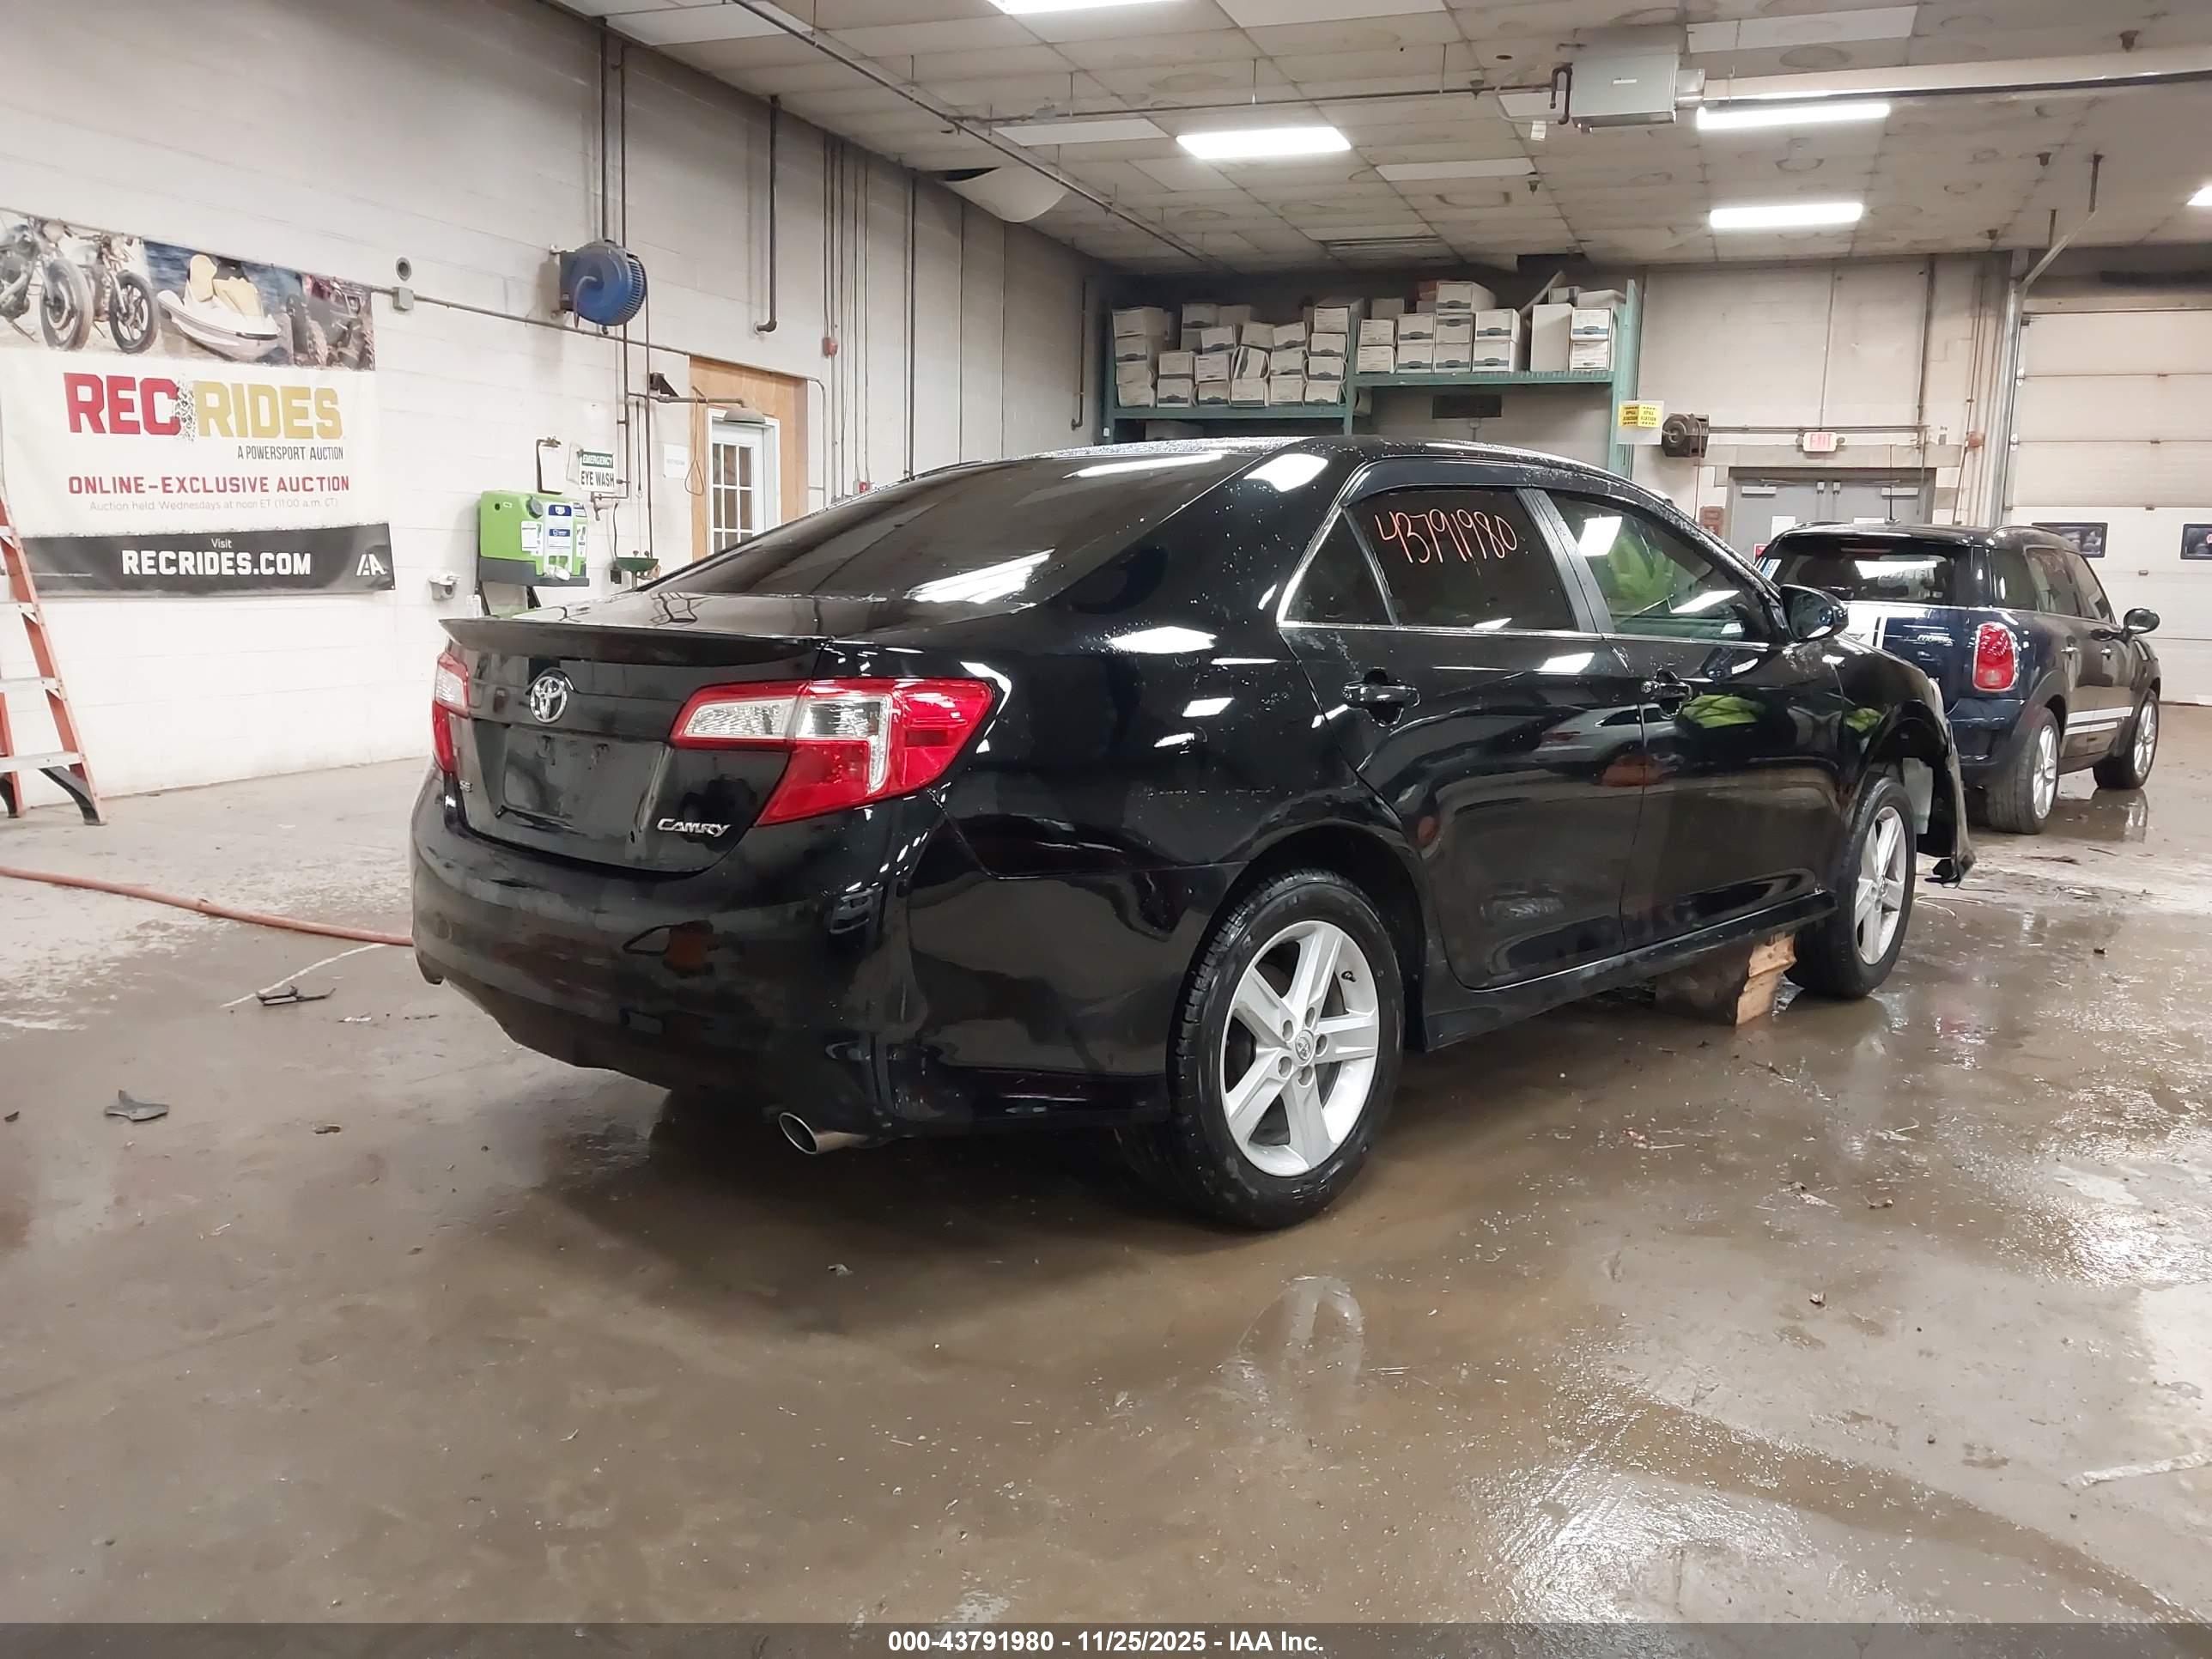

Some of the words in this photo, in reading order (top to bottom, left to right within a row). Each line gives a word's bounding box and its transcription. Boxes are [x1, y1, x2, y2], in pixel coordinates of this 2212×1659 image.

[1809, 433, 1833, 449] EXIT
[237, 446, 244, 460] A
[246, 446, 306, 461] POWERSPORT
[310, 447, 343, 461] AUCTION
[582, 453, 613, 466] EMERGENCY
[69, 476, 270, 495] ONLINE-EXCLUSIVE
[276, 476, 349, 493] AUCTION
[581, 471, 594, 486] EYE
[595, 471, 615, 488] WASH
[89, 501, 129, 511] Auction
[132, 501, 155, 510] held
[158, 501, 221, 512] Wednesdays
[224, 500, 234, 509] at
[236, 500, 258, 509] noon
[260, 499, 271, 508] ET
[211, 538, 233, 549] Visit
[1375, 508, 1517, 563] 43791980
[121, 550, 312, 575] RECRIDES.COM
